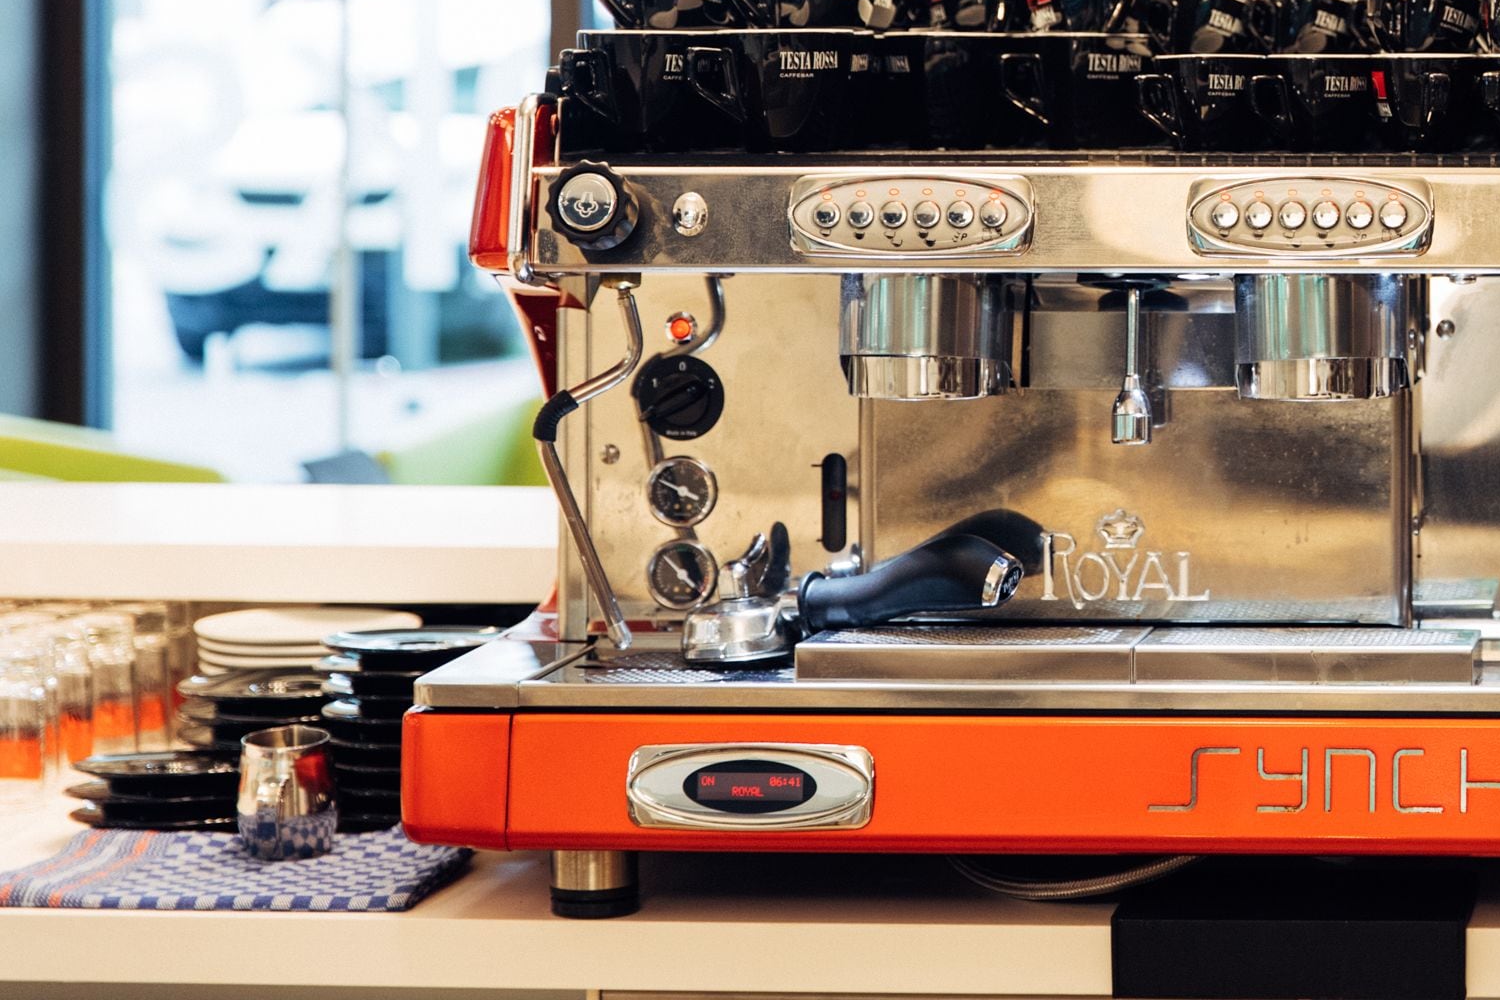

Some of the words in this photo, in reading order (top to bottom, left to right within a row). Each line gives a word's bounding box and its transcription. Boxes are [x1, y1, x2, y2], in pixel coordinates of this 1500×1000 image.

[664, 53, 684, 72] TES
[779, 51, 812, 70] TESTA
[812, 50, 839, 69] ROSSA
[1087, 53, 1118, 72] TESTA
[1208, 73, 1234, 90] TESTA
[1324, 75, 1349, 92] TESTA
[652, 378, 658, 389] 1
[1040, 532, 1210, 610] ROYAL
[701, 776, 716, 786] ON
[731, 786, 764, 797] ROYAL
